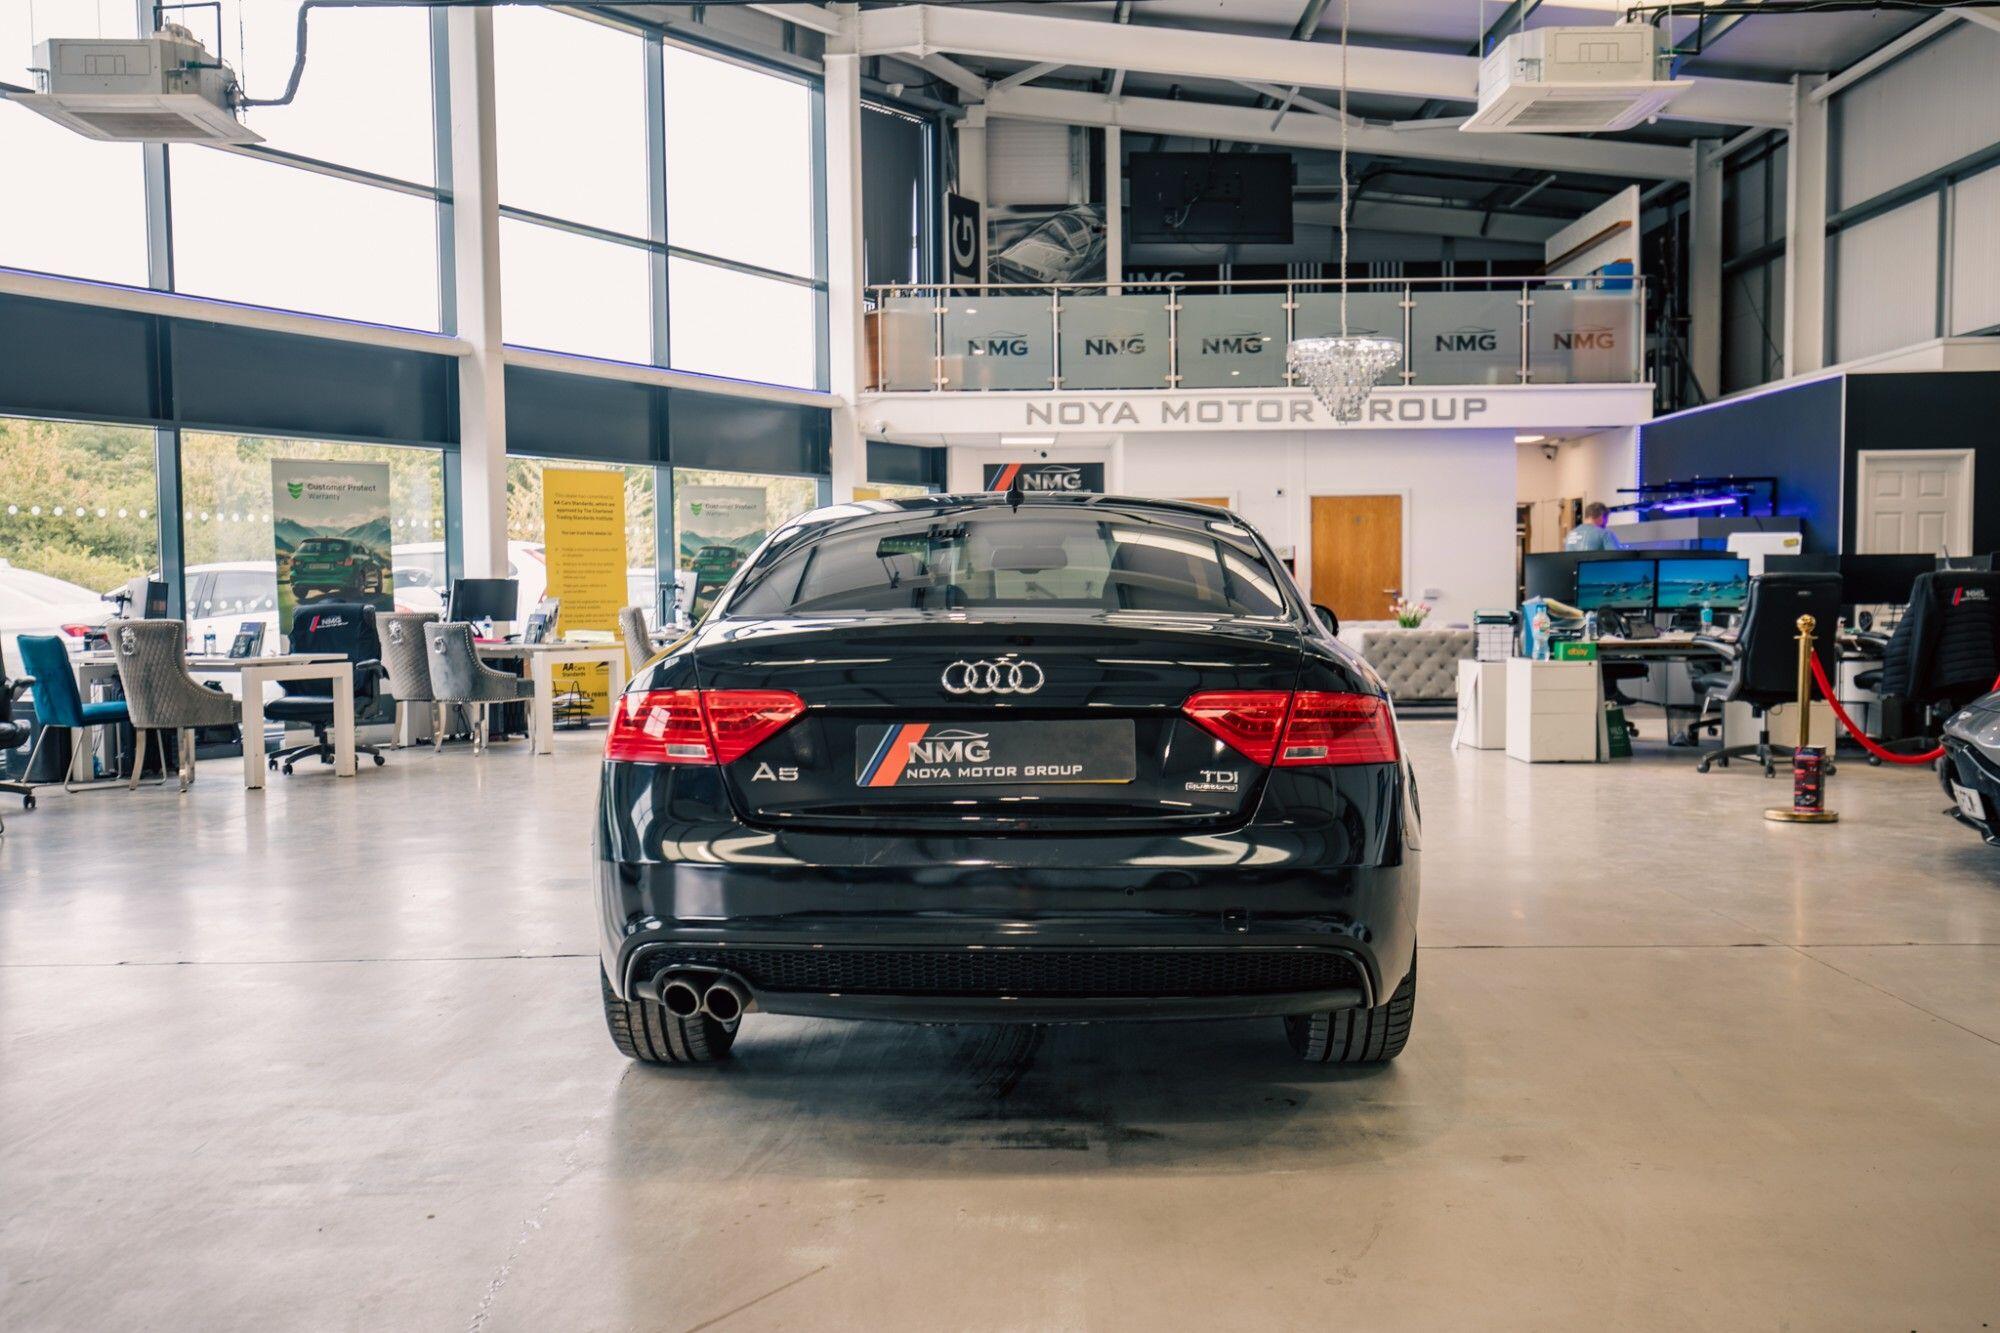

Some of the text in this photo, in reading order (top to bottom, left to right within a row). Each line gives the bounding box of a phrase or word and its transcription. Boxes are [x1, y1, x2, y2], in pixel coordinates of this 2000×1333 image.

[968, 339, 1028, 356] NMG
[1201, 337, 1263, 354] NMG
[1435, 334, 1496, 351] NMG
[1553, 332, 1615, 350] NMG
[1026, 401, 1139, 425] NOYA
[1161, 399, 1315, 423] MOTOR
[307, 483, 376, 492] Customer Protect
[1023, 473, 1081, 490] NMG
[562, 663, 574, 671] AA
[908, 740, 991, 764] NMG
[751, 761, 799, 781] A5
[906, 765, 1083, 779] NOYA MOTOR GROUP
[1200, 770, 1239, 783] TDI
